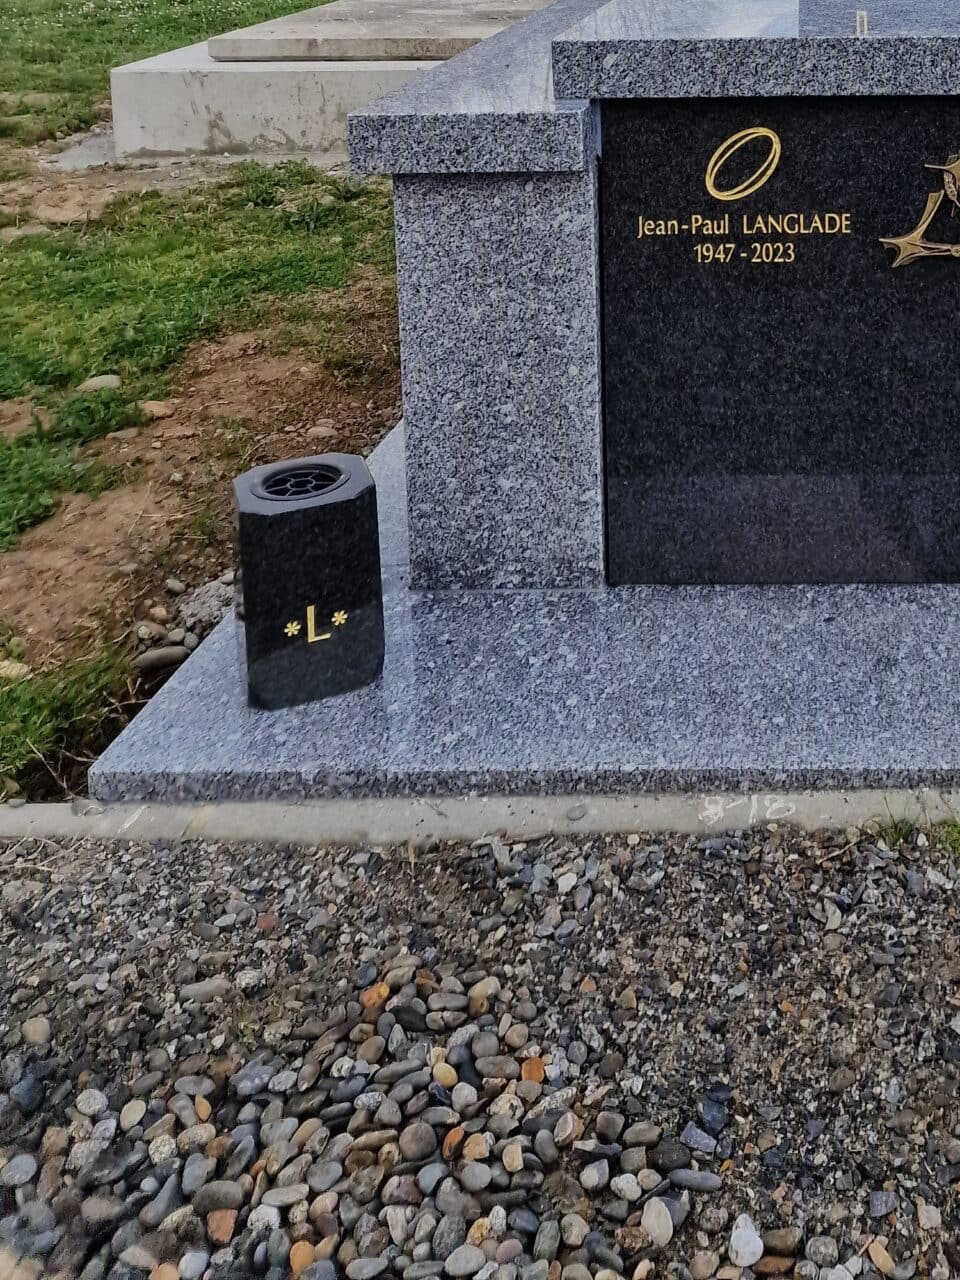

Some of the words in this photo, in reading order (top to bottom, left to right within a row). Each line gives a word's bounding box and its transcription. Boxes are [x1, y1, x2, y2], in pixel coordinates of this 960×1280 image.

[637, 213, 730, 239] Jean-Paul
[743, 213, 852, 235] LANGLADE
[693, 243, 736, 264] 1947
[751, 242, 796, 264] 2023
